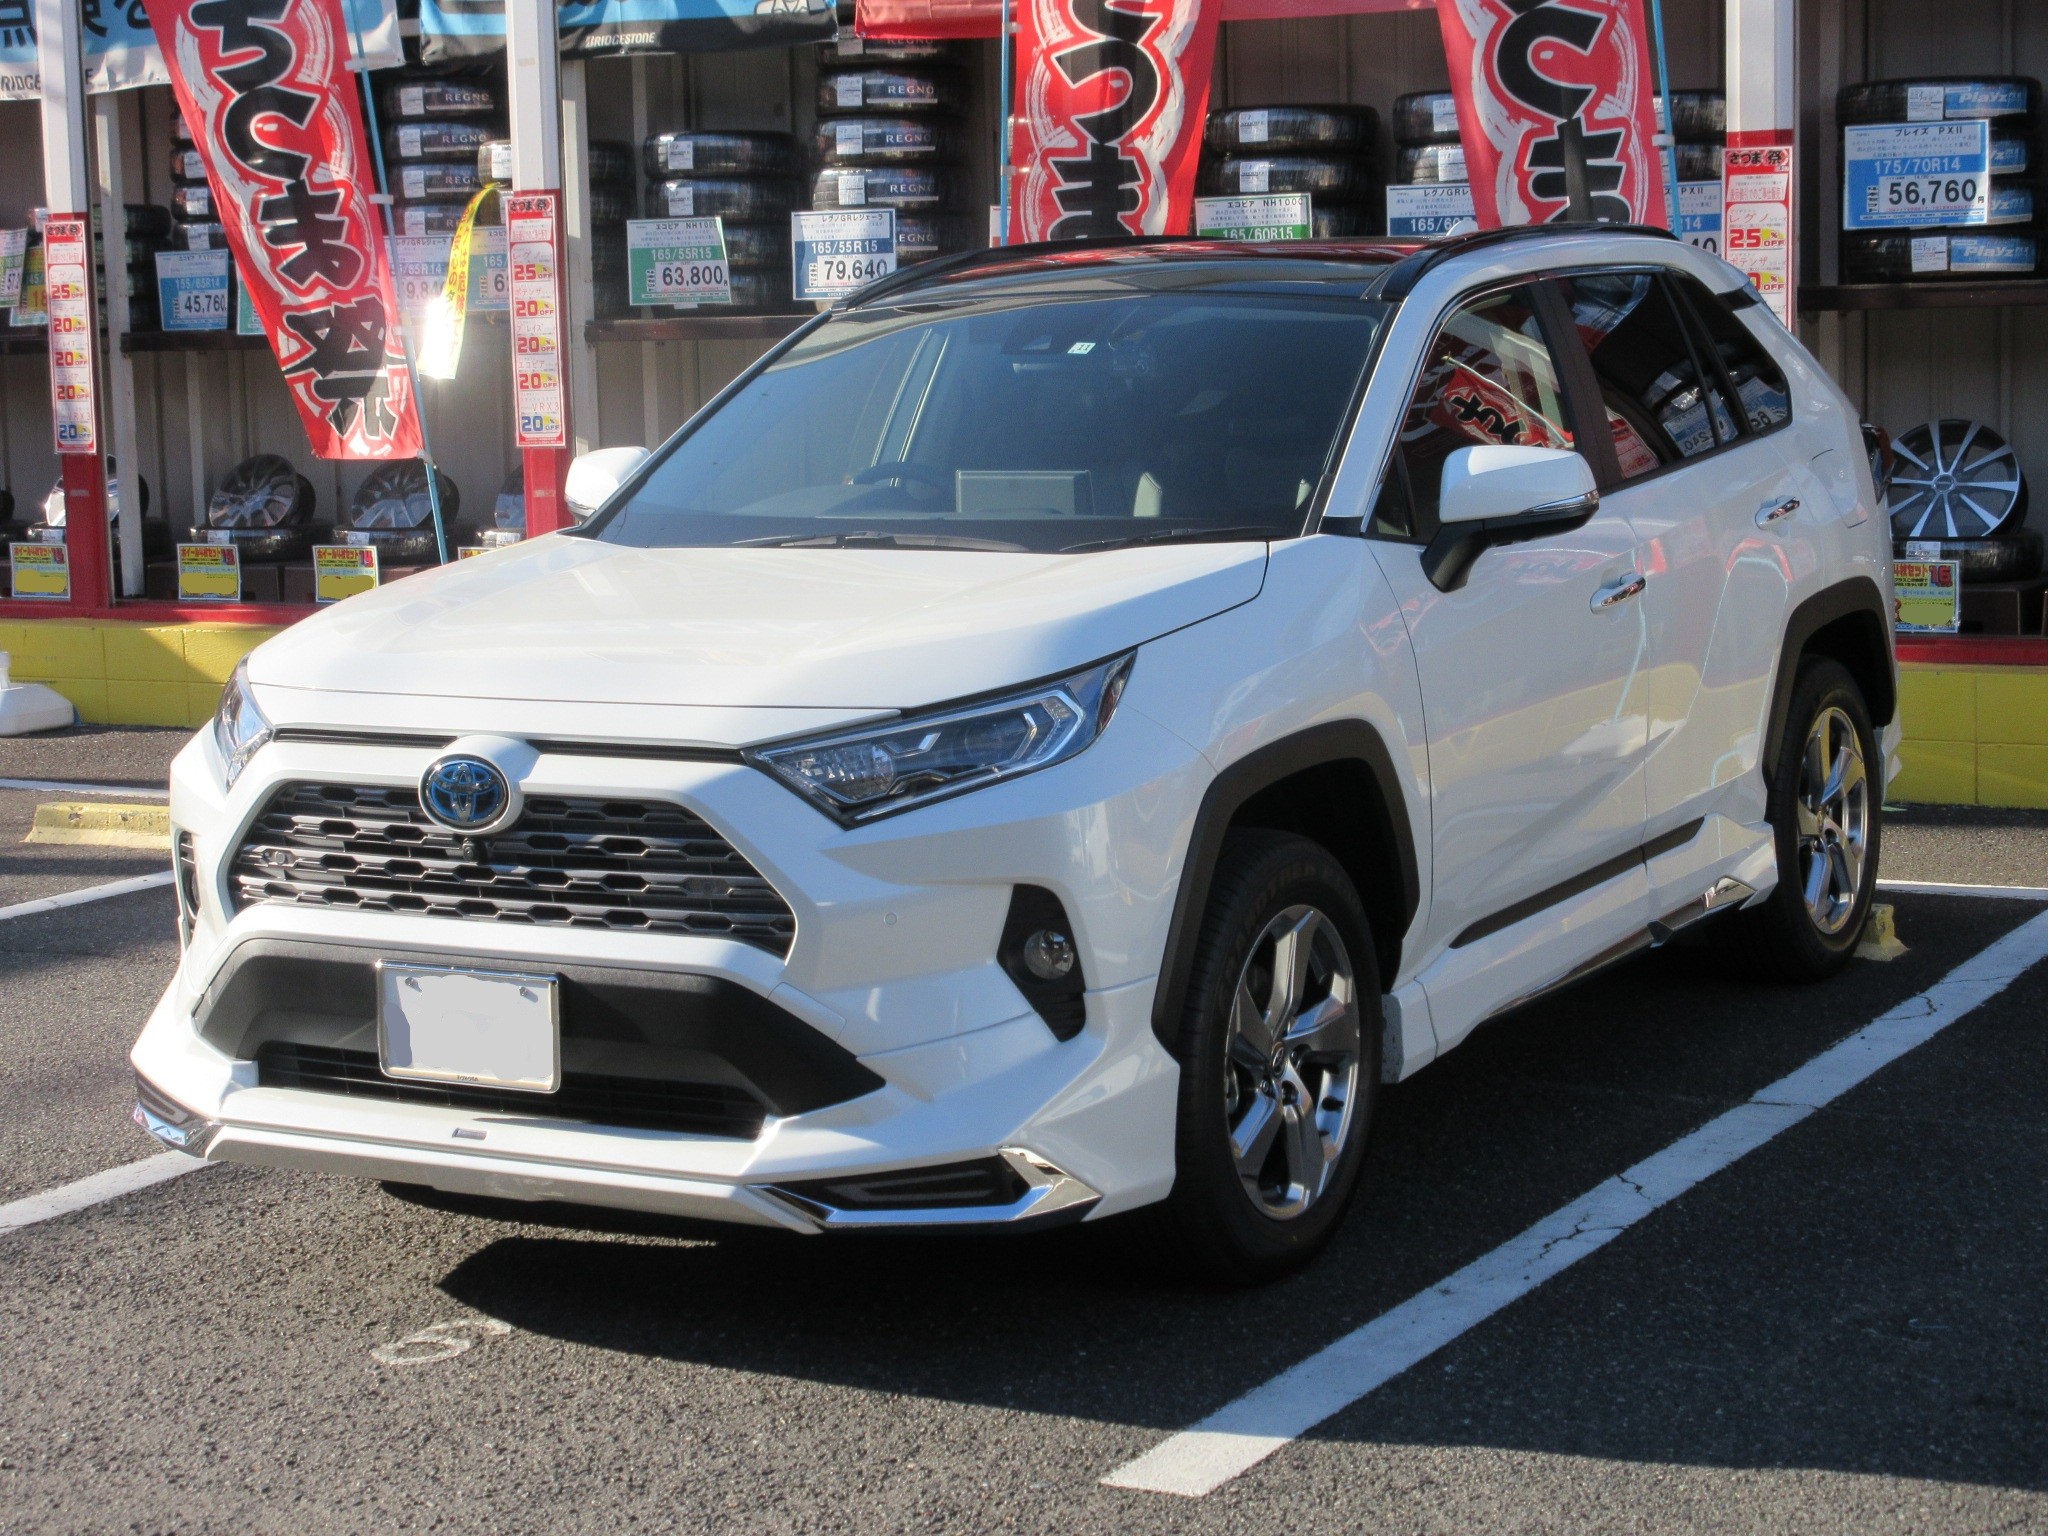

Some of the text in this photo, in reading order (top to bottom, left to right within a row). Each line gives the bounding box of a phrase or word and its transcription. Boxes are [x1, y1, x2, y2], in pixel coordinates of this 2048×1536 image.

[585, 32, 656, 49] BRIDGESTONE
[445, 93, 490, 102] REGNO
[888, 85, 935, 95] REGNO
[442, 134, 488, 144] REGNO
[885, 133, 932, 144] REGNO
[1874, 157, 1961, 175] 175/70R14
[1888, 178, 1977, 206] 56,760
[1227, 200, 1255, 209] エコピア
[1729, 212, 1769, 224] レグノ
[1222, 226, 1294, 240] 165/60R15
[1729, 228, 1761, 248] 25
[651, 247, 712, 261] 165/55R15
[811, 240, 878, 254] 165/55R15
[514, 263, 537, 281] 25
[662, 265, 723, 287] 63,800
[824, 259, 888, 281] 79,640
[51, 284, 71, 299] 25
[175, 277, 221, 290] 155/65R14
[1763, 283, 1785, 291] OFF
[184, 293, 226, 313] 45,760
[515, 300, 538, 317] 20
[53, 317, 72, 333] 20
[517, 336, 540, 353] 20
[55, 351, 74, 367] 20
[519, 373, 541, 390] 20
[56, 385, 76, 400] 20
[521, 415, 544, 432] 20
[59, 424, 78, 440] 20
[456, 1074, 479, 1082] TOYOTA
